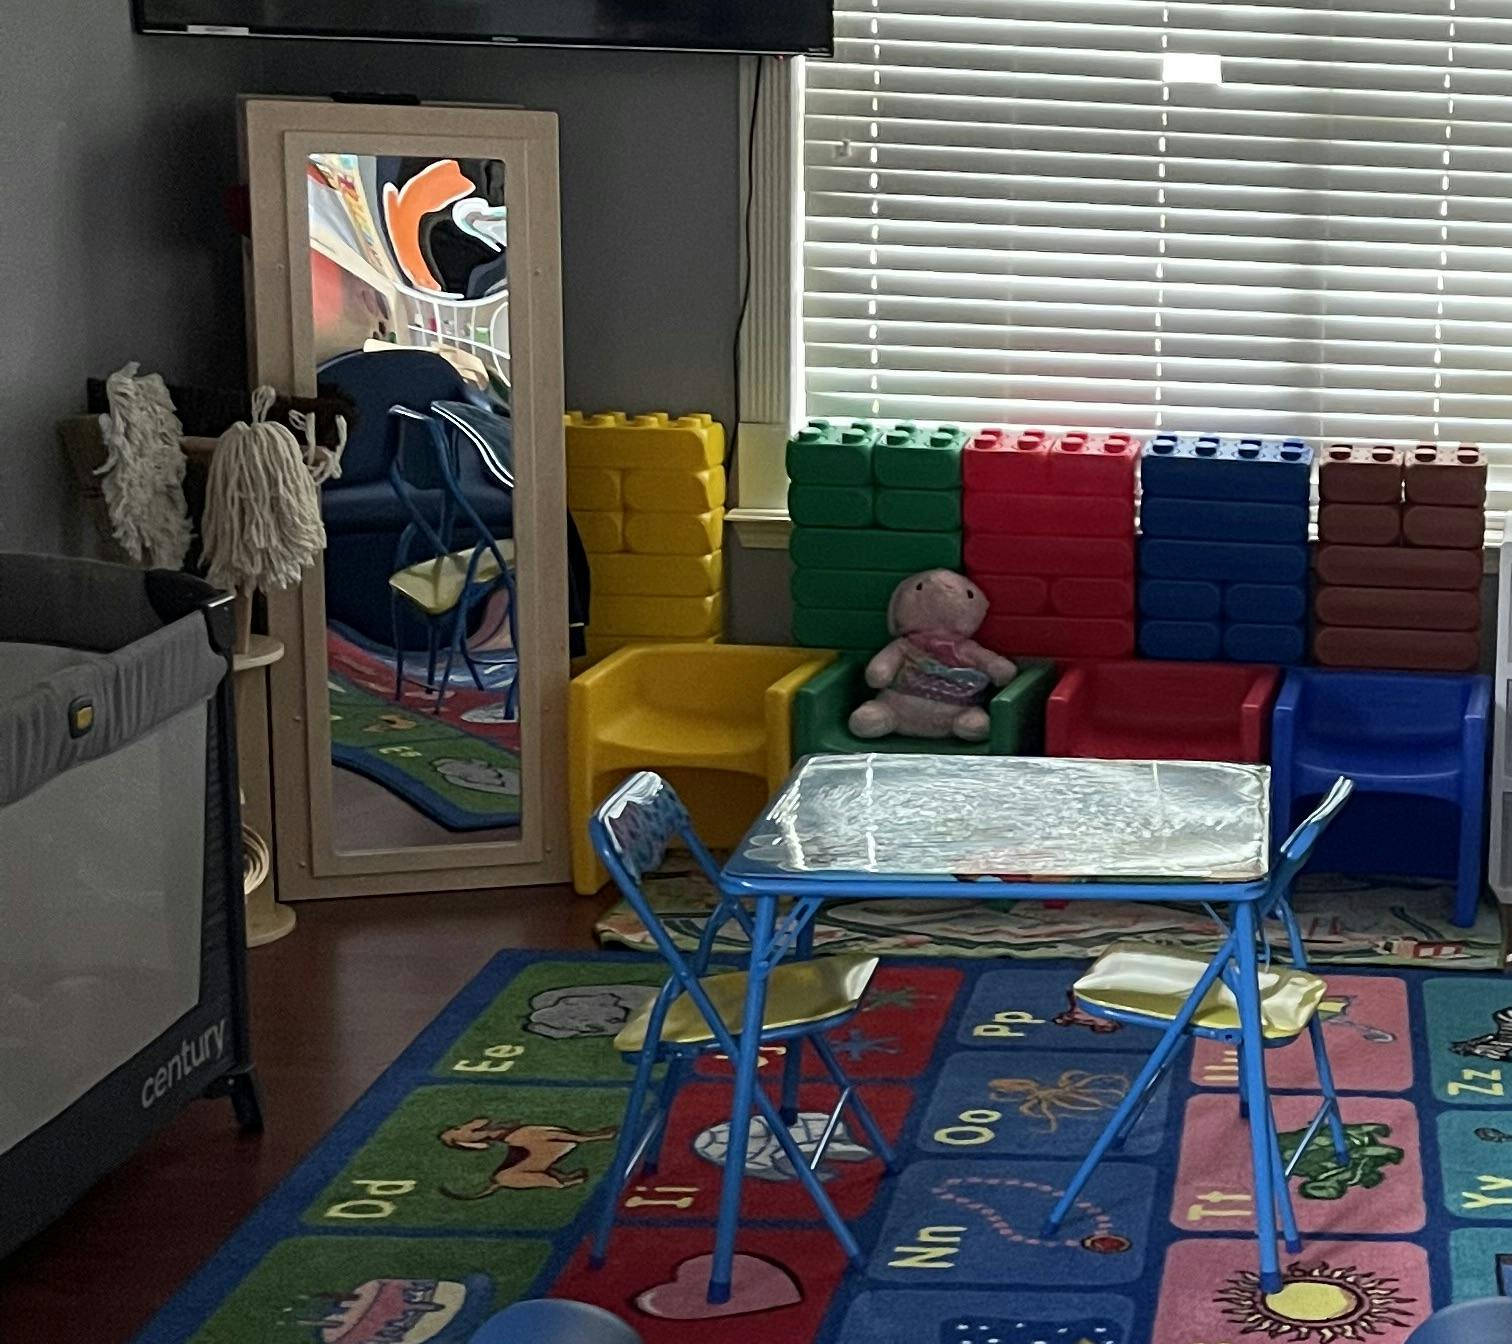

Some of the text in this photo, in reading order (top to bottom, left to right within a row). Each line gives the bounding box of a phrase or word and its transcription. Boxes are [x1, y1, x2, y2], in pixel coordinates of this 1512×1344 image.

[972, 1008, 1047, 1040] Pp
[139, 1016, 230, 1111] century
[454, 1043, 527, 1076] Ee
[1448, 1066, 1504, 1098] Zz
[932, 1108, 1002, 1148] Oo
[323, 1178, 419, 1220] Dd
[1186, 1192, 1253, 1229] Tt
[893, 1225, 968, 1270] Nn
